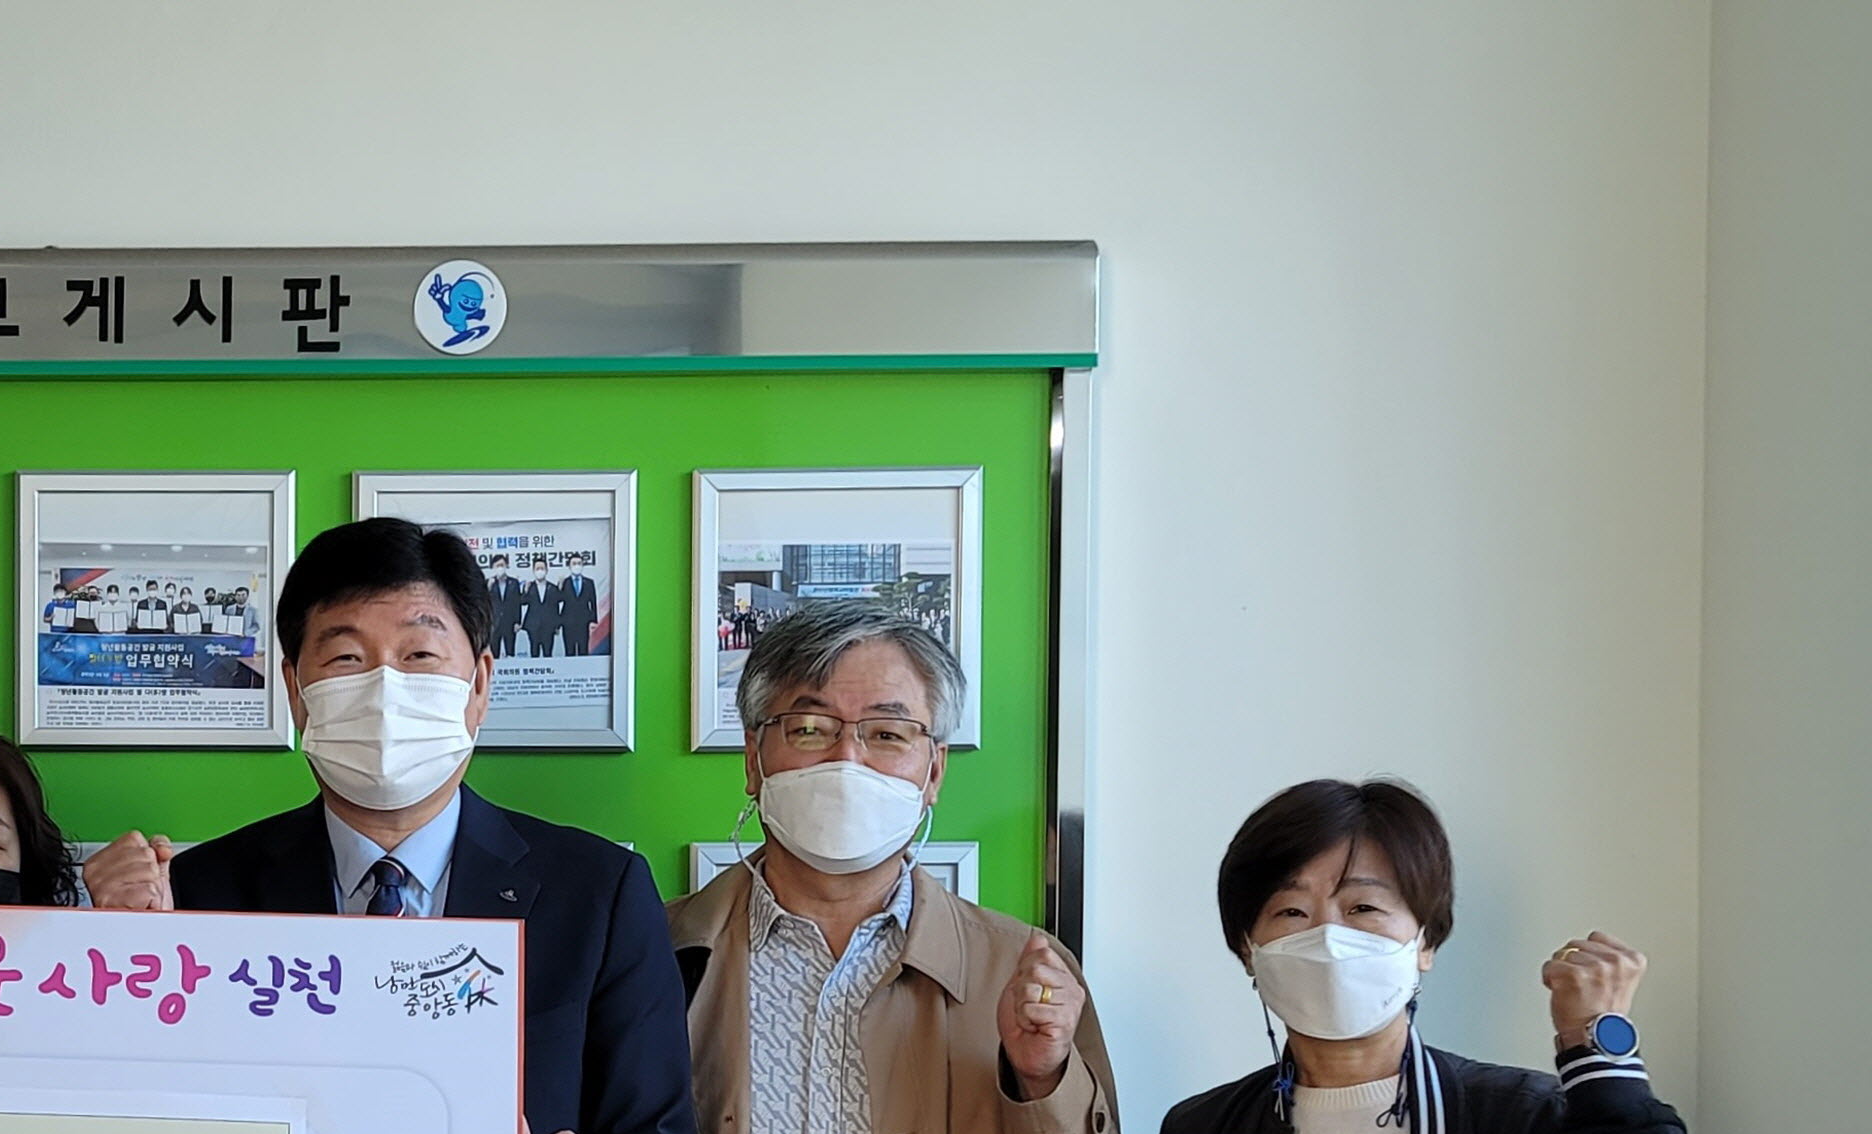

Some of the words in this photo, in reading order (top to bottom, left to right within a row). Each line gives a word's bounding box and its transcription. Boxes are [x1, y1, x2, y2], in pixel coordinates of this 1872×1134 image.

[465, 539, 480, 550] 전
[482, 537, 493, 549] 및
[496, 536, 528, 549] 협력을
[532, 536, 554, 548] 위한
[125, 654, 194, 669] 업무협약식
[38, 944, 212, 1027] 사랑
[228, 952, 344, 1017] 실천
[404, 993, 459, 1020] 중앙동
